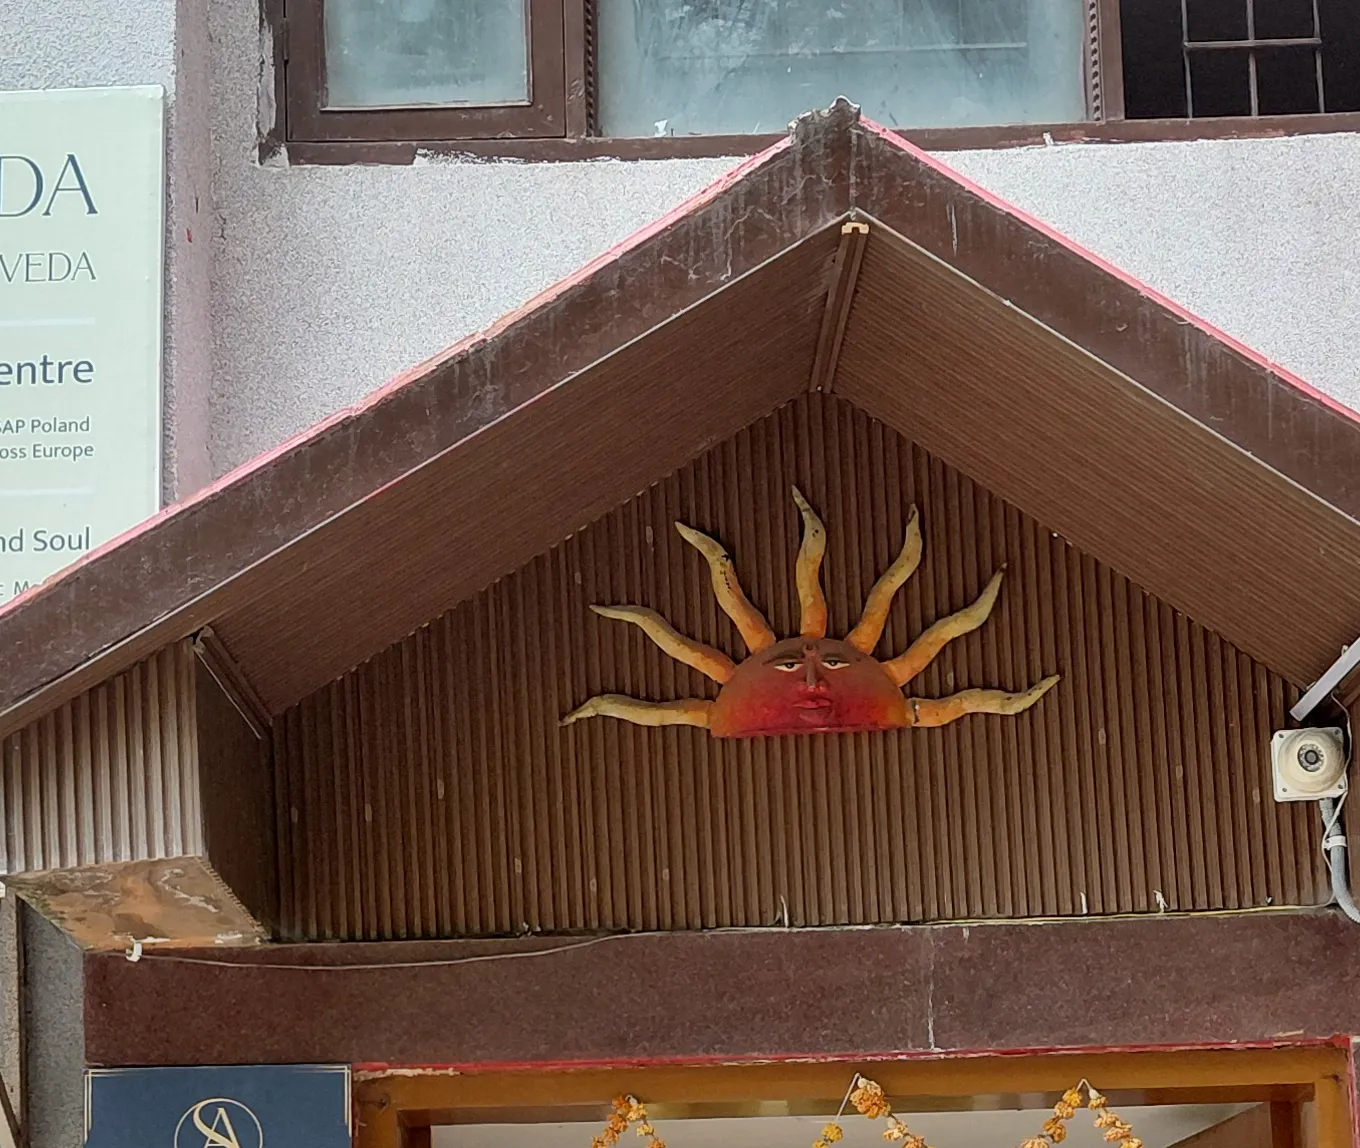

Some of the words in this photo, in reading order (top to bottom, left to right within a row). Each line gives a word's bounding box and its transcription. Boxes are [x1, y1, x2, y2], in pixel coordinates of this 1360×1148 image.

[30, 415, 90, 434] Poland
[32, 443, 95, 462] Europe
[33, 526, 90, 552] Soul
